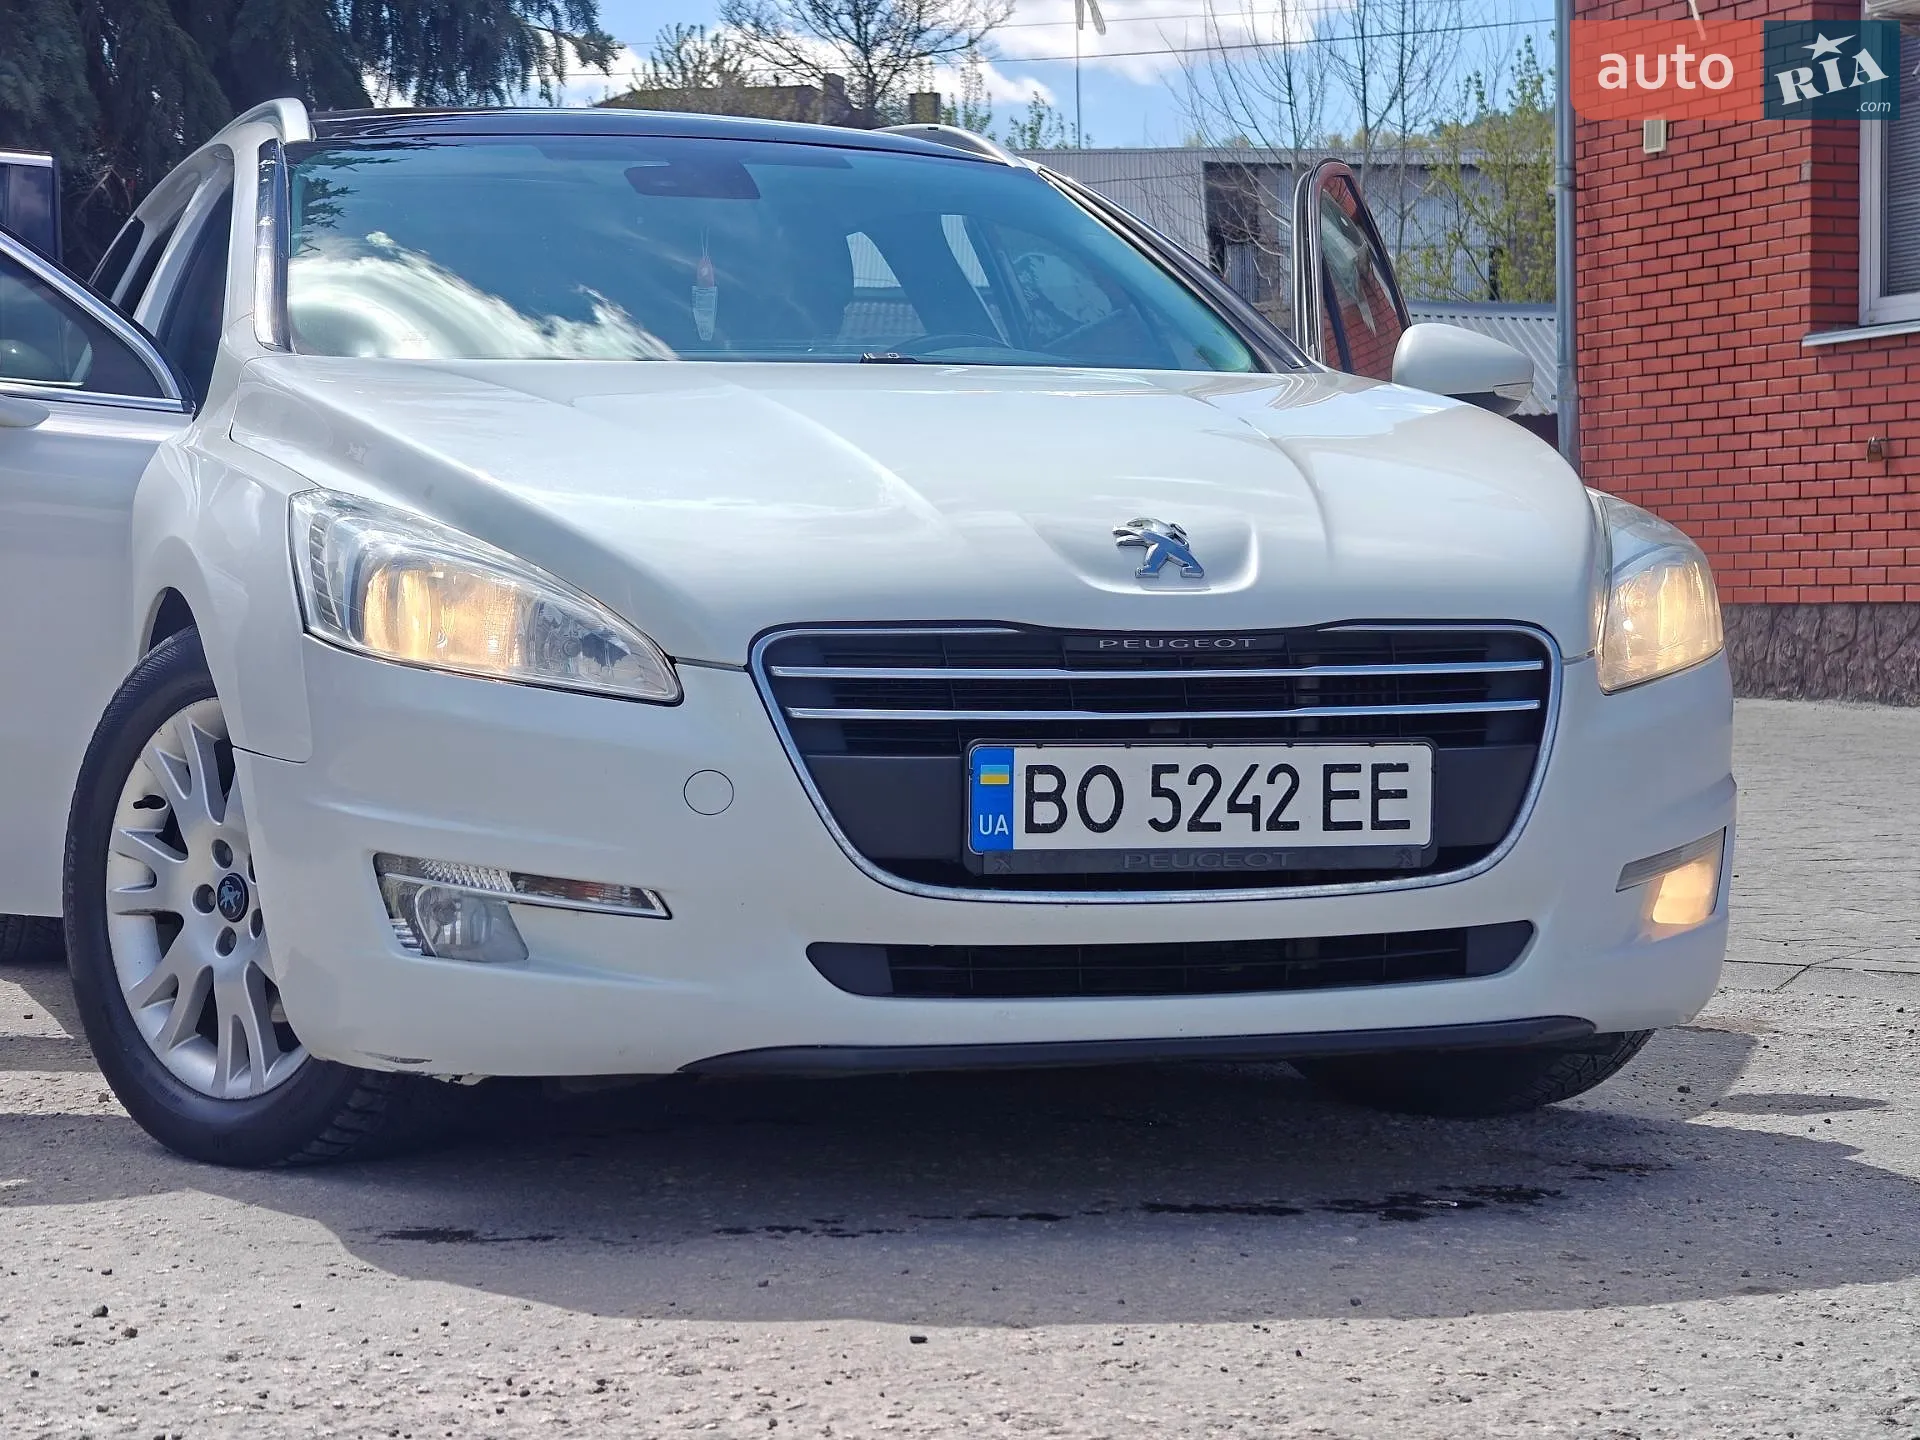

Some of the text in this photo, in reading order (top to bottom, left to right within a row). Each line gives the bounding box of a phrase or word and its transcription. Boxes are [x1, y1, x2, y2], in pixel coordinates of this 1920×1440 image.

[1099, 638, 1256, 648] PEUGEOT
[1024, 762, 1411, 834] BO 5242 EE
[979, 814, 1009, 835] UA
[1123, 852, 1296, 869] PEUGEOT
